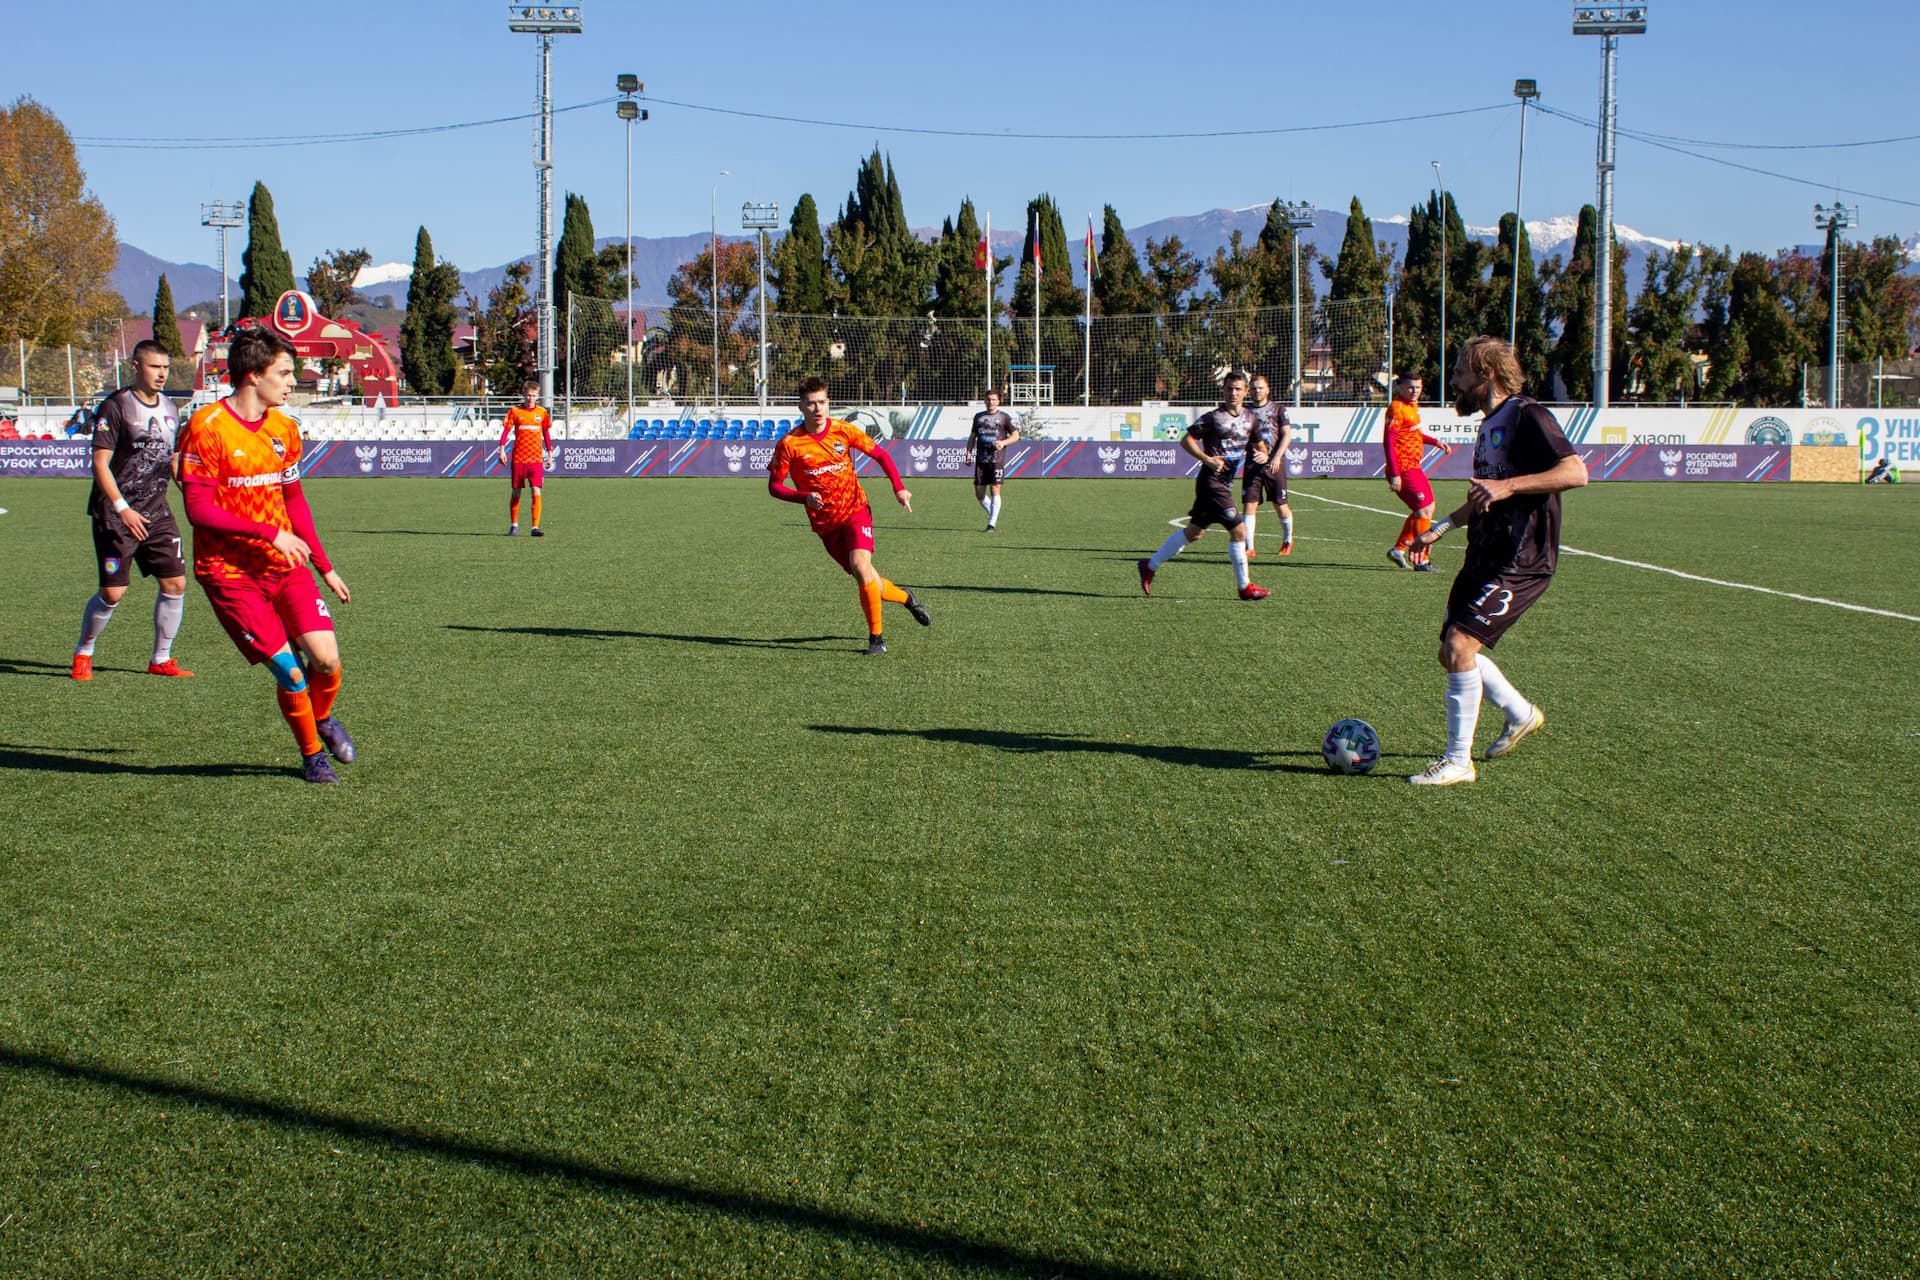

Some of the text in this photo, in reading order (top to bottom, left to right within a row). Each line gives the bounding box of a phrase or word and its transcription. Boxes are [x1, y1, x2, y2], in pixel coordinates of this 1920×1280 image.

[1857, 417, 1880, 461] 3
[381, 448, 431, 456] РОССИЙСКИЙ
[564, 447, 615, 455] РОССИЙСКИЙ
[1311, 450, 1363, 458] РОССИЙСКИЙ
[1686, 452, 1737, 460] РОССИЙСКИЙ
[41, 459, 84, 469] СРЕДИ
